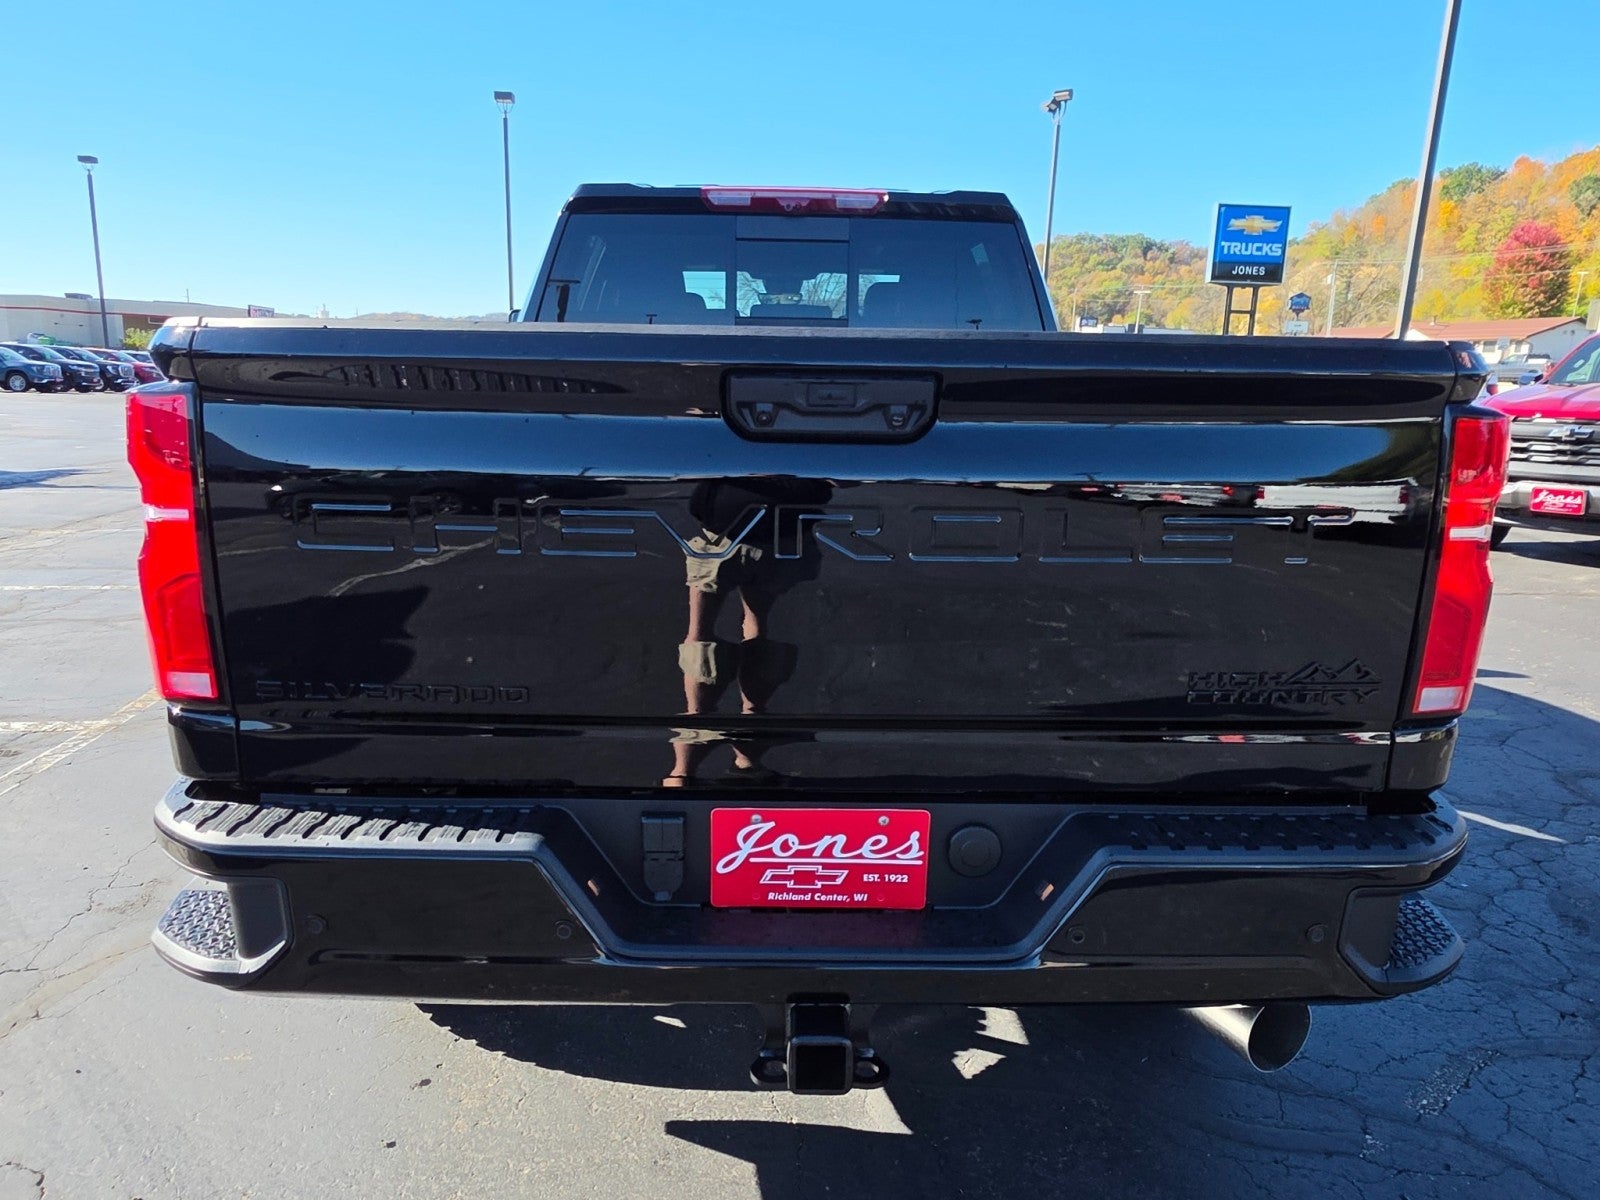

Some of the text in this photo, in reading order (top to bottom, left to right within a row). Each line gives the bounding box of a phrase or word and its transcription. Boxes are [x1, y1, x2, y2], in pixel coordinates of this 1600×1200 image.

[1221, 241, 1282, 256] TRUCKS
[1232, 265, 1266, 276] JONES
[292, 496, 1356, 565] CHEVROLET
[256, 680, 530, 704] SILVERADO
[716, 821, 925, 874] Jones
[863, 874, 909, 883] EST. 1922
[768, 892, 868, 903] Richland Center, WI
